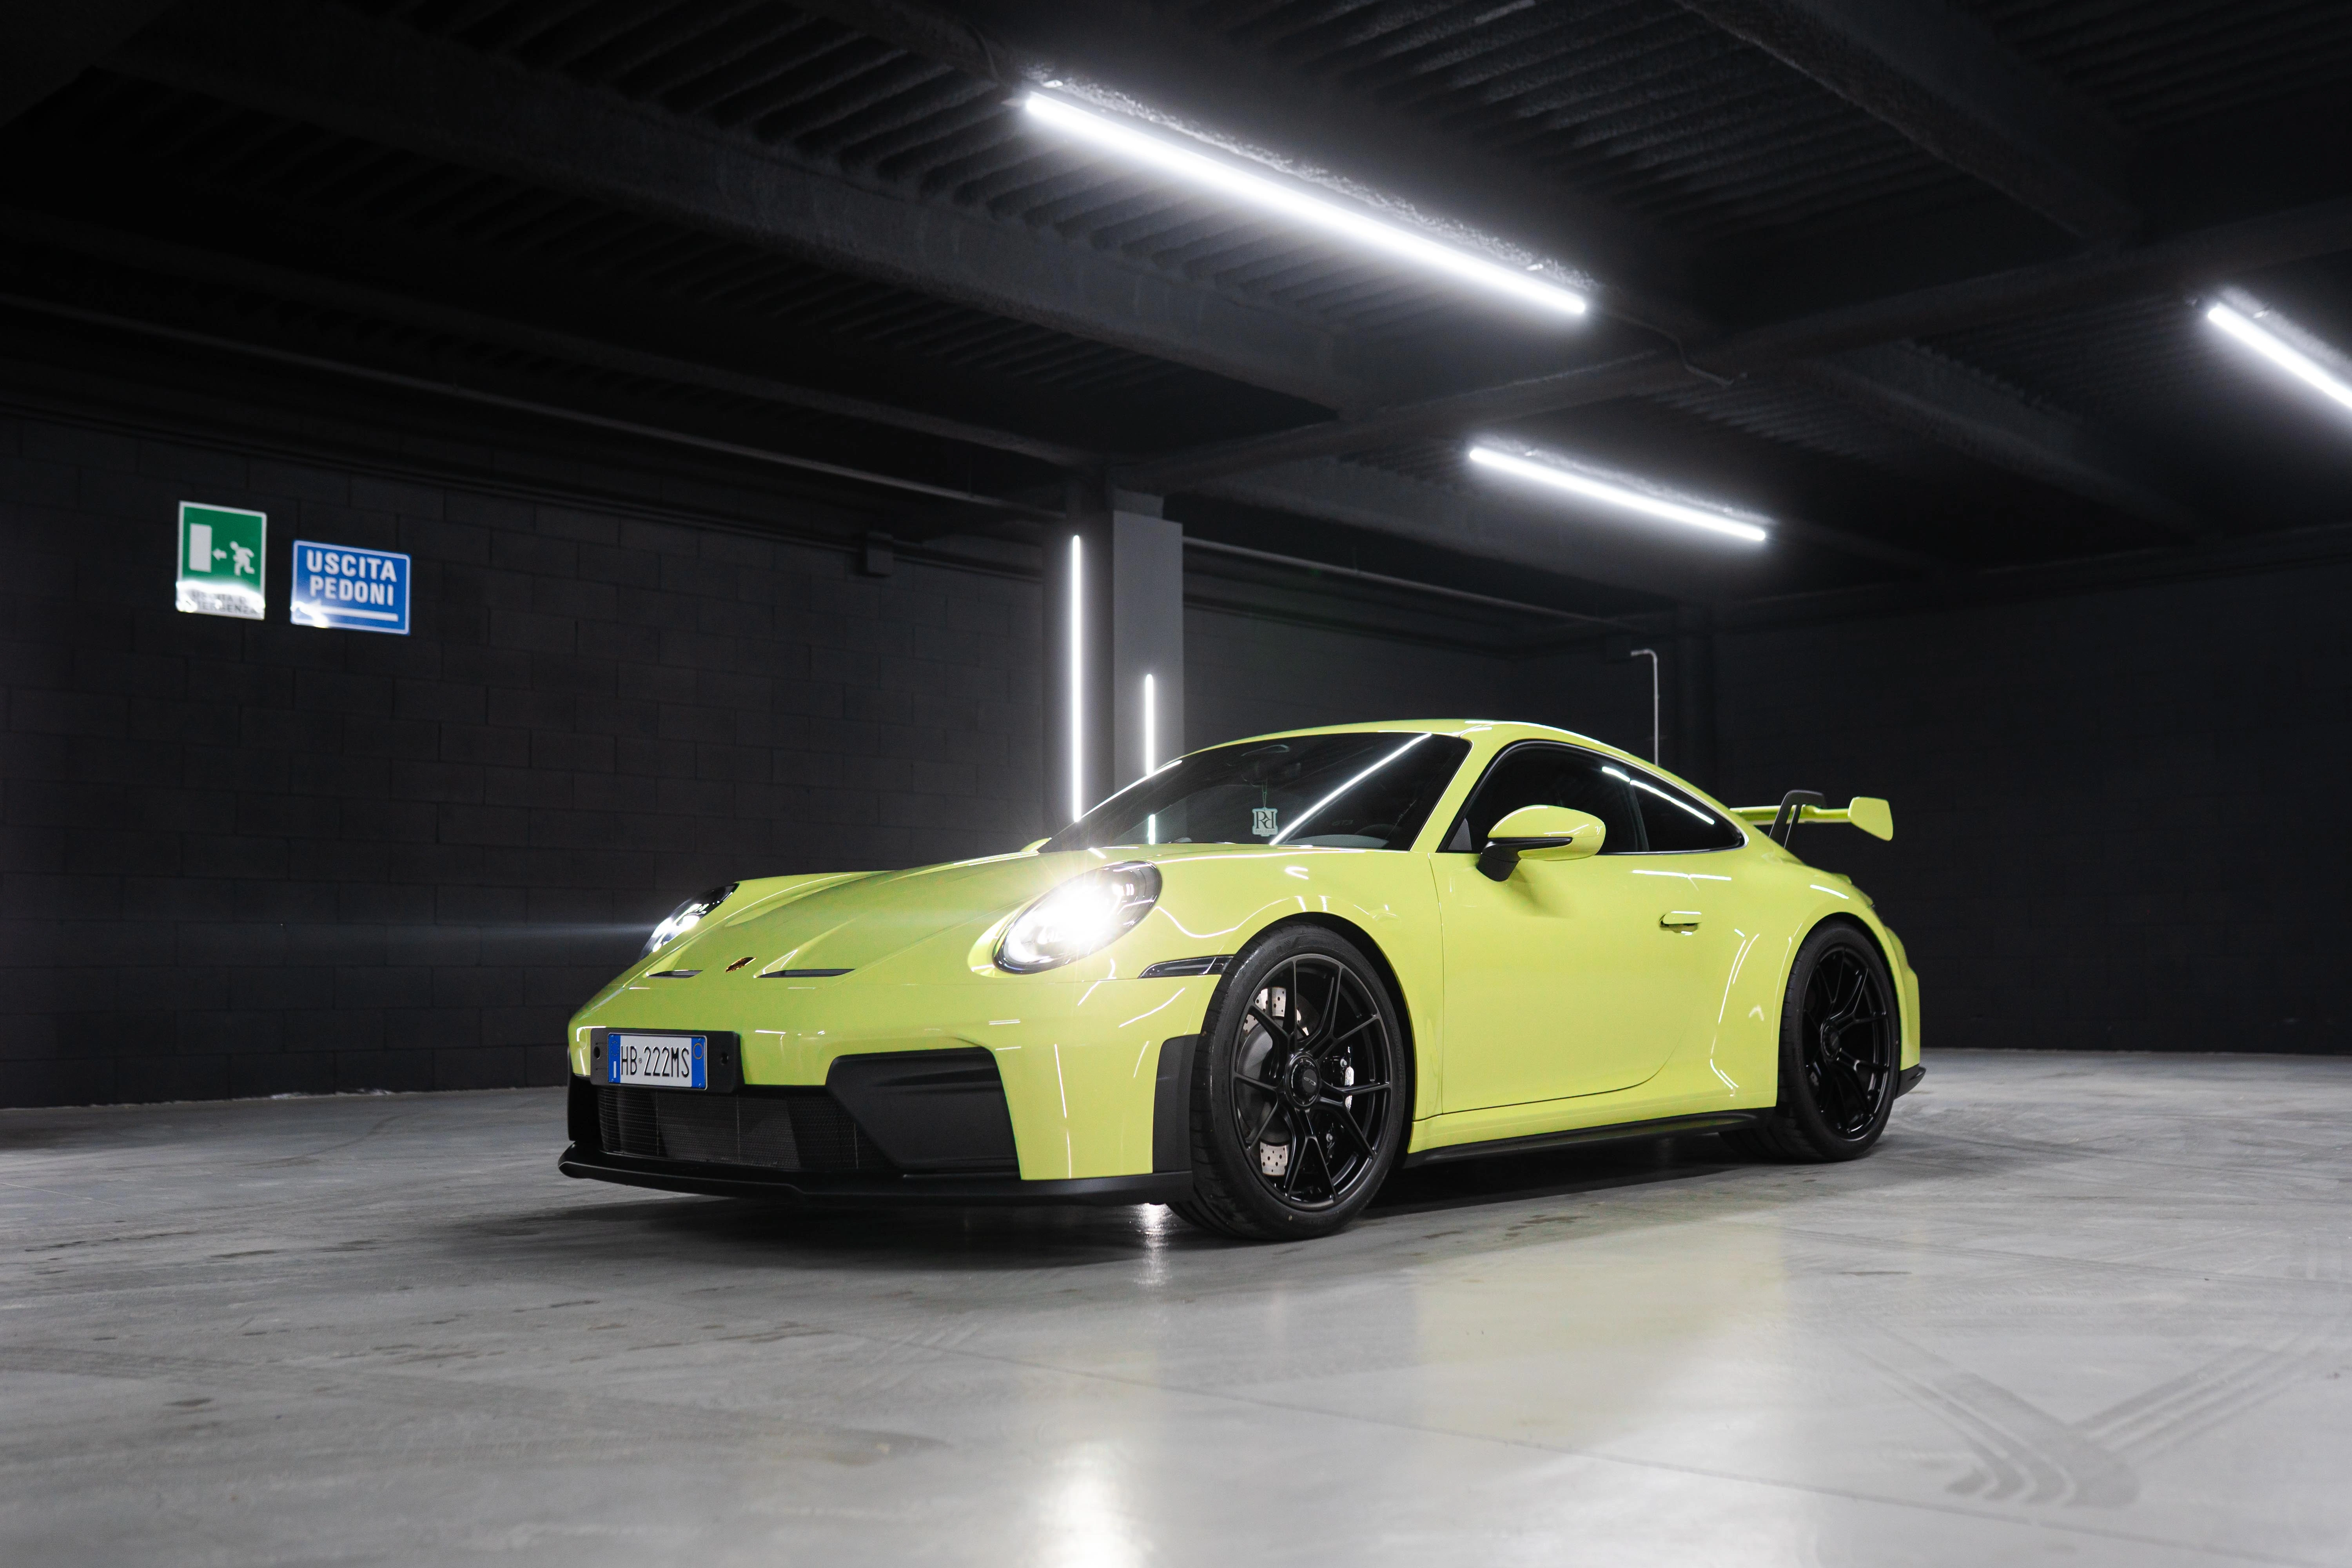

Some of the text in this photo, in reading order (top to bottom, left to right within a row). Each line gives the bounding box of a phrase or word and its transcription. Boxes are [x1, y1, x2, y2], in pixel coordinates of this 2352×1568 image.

[307, 549, 397, 583] USCITA
[309, 574, 394, 606] PEDONI
[1303, 1077, 1316, 1086] GT3
